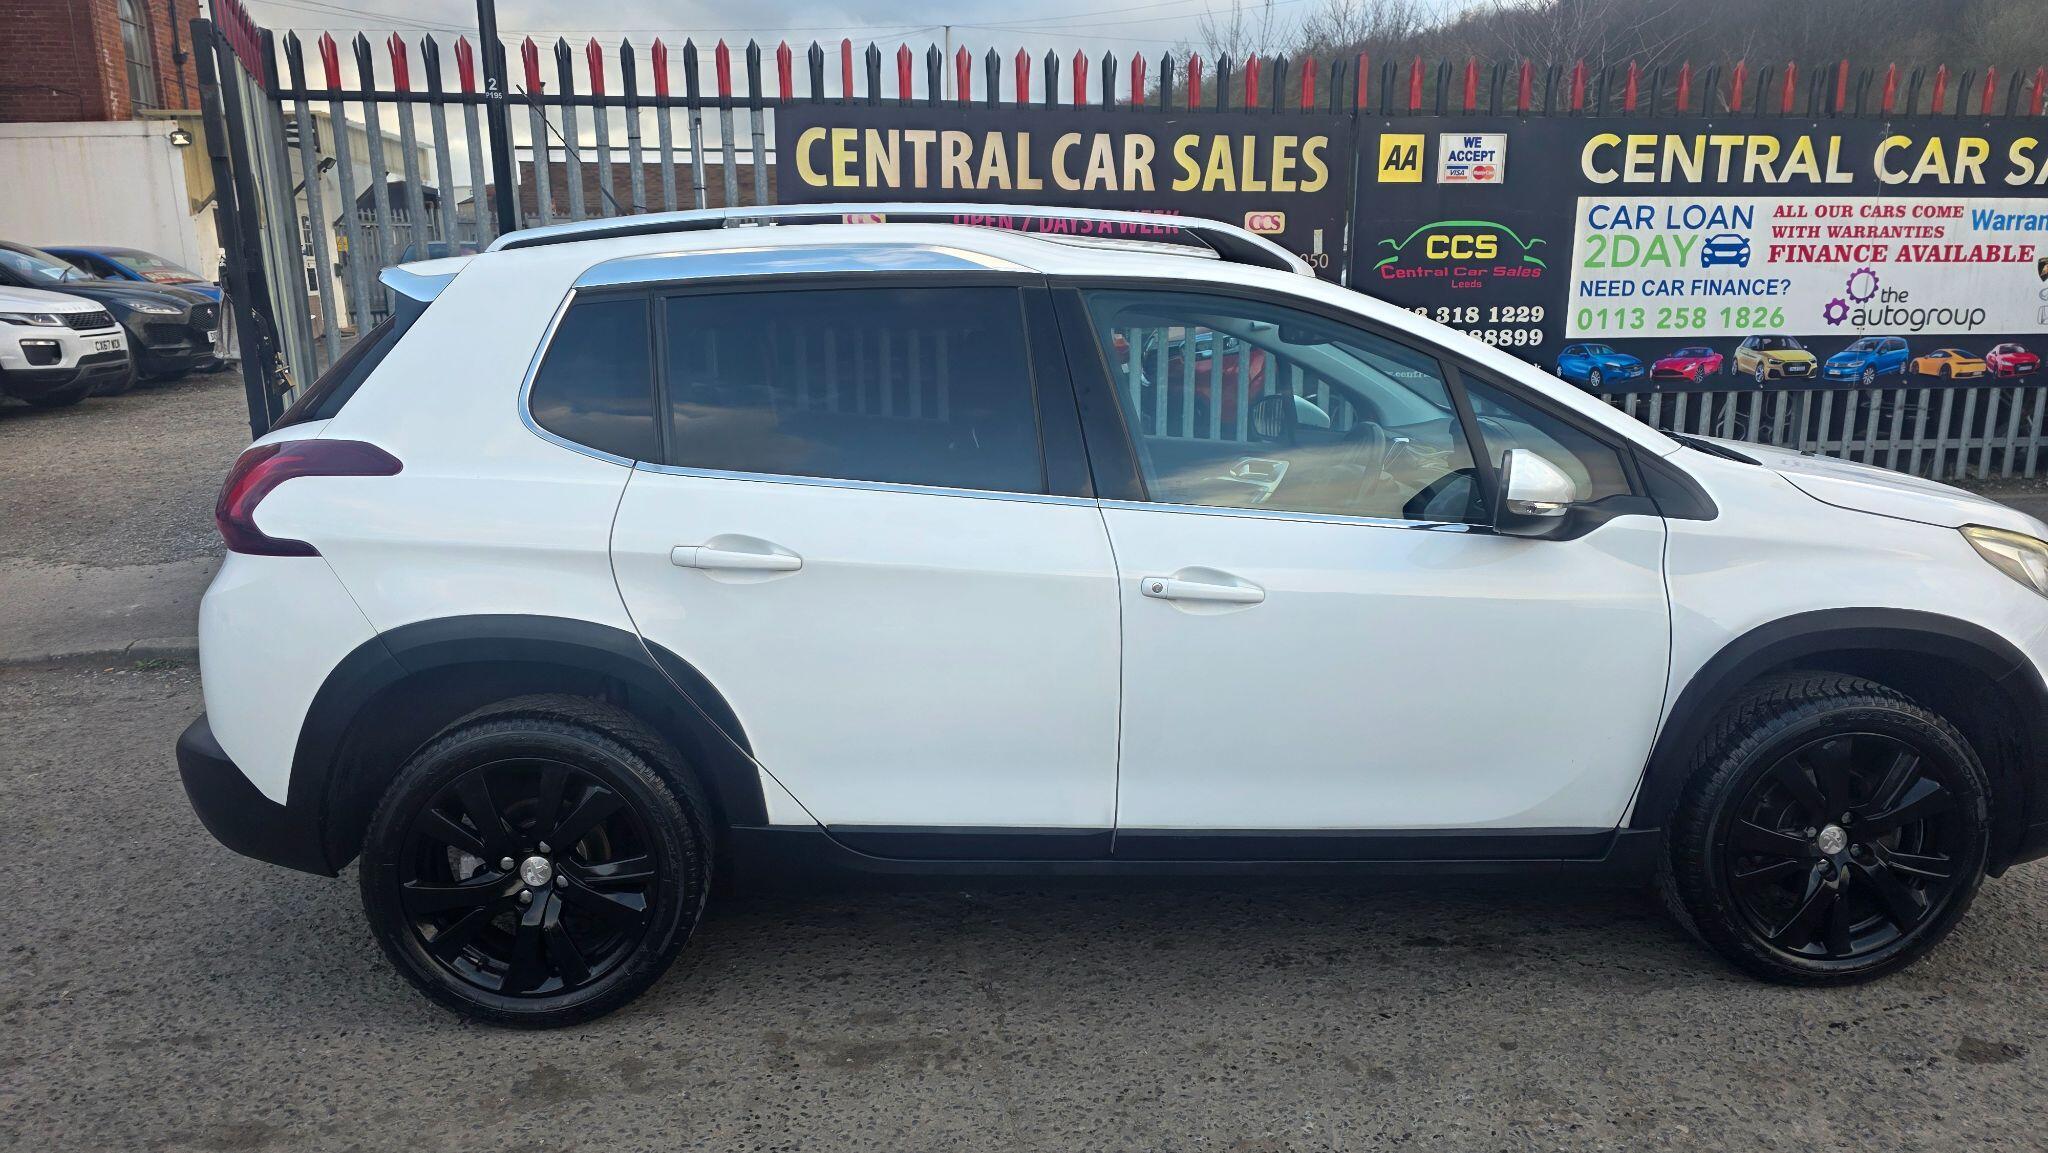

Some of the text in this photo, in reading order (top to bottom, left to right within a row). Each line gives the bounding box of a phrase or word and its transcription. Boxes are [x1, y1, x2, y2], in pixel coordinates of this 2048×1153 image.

[488, 78, 497, 91] 2
[1463, 137, 1482, 148] WE
[795, 126, 1329, 193] CENTRAL CAR SALES
[1383, 144, 1418, 170] AA
[1448, 151, 1495, 161] ACCEPT
[1581, 133, 1854, 184] CENTRAL
[1873, 135, 1990, 185] CAR
[1588, 204, 1754, 230] CAR LOAN
[1773, 205, 1964, 219] ALL OUR CARS COME
[1249, 215, 1281, 231] CCS
[1772, 226, 1945, 239] WITH WARRANTIES
[1427, 234, 1498, 260] CCS
[1584, 234, 1699, 268] 2DAY
[1767, 245, 2036, 263] FINANCE AVAILABLE
[1381, 265, 1542, 279] Central Car Sales
[1451, 280, 1482, 288] Leeds
[1580, 278, 1791, 297] NEED CAR FINANCE?
[1881, 287, 1909, 304] the
[1436, 306, 1480, 324] 318
[1488, 306, 1545, 323] 1229
[1577, 307, 1785, 330] 0113 258 1826
[1851, 305, 1986, 332] autogroup
[1457, 329, 1543, 347] 88899
